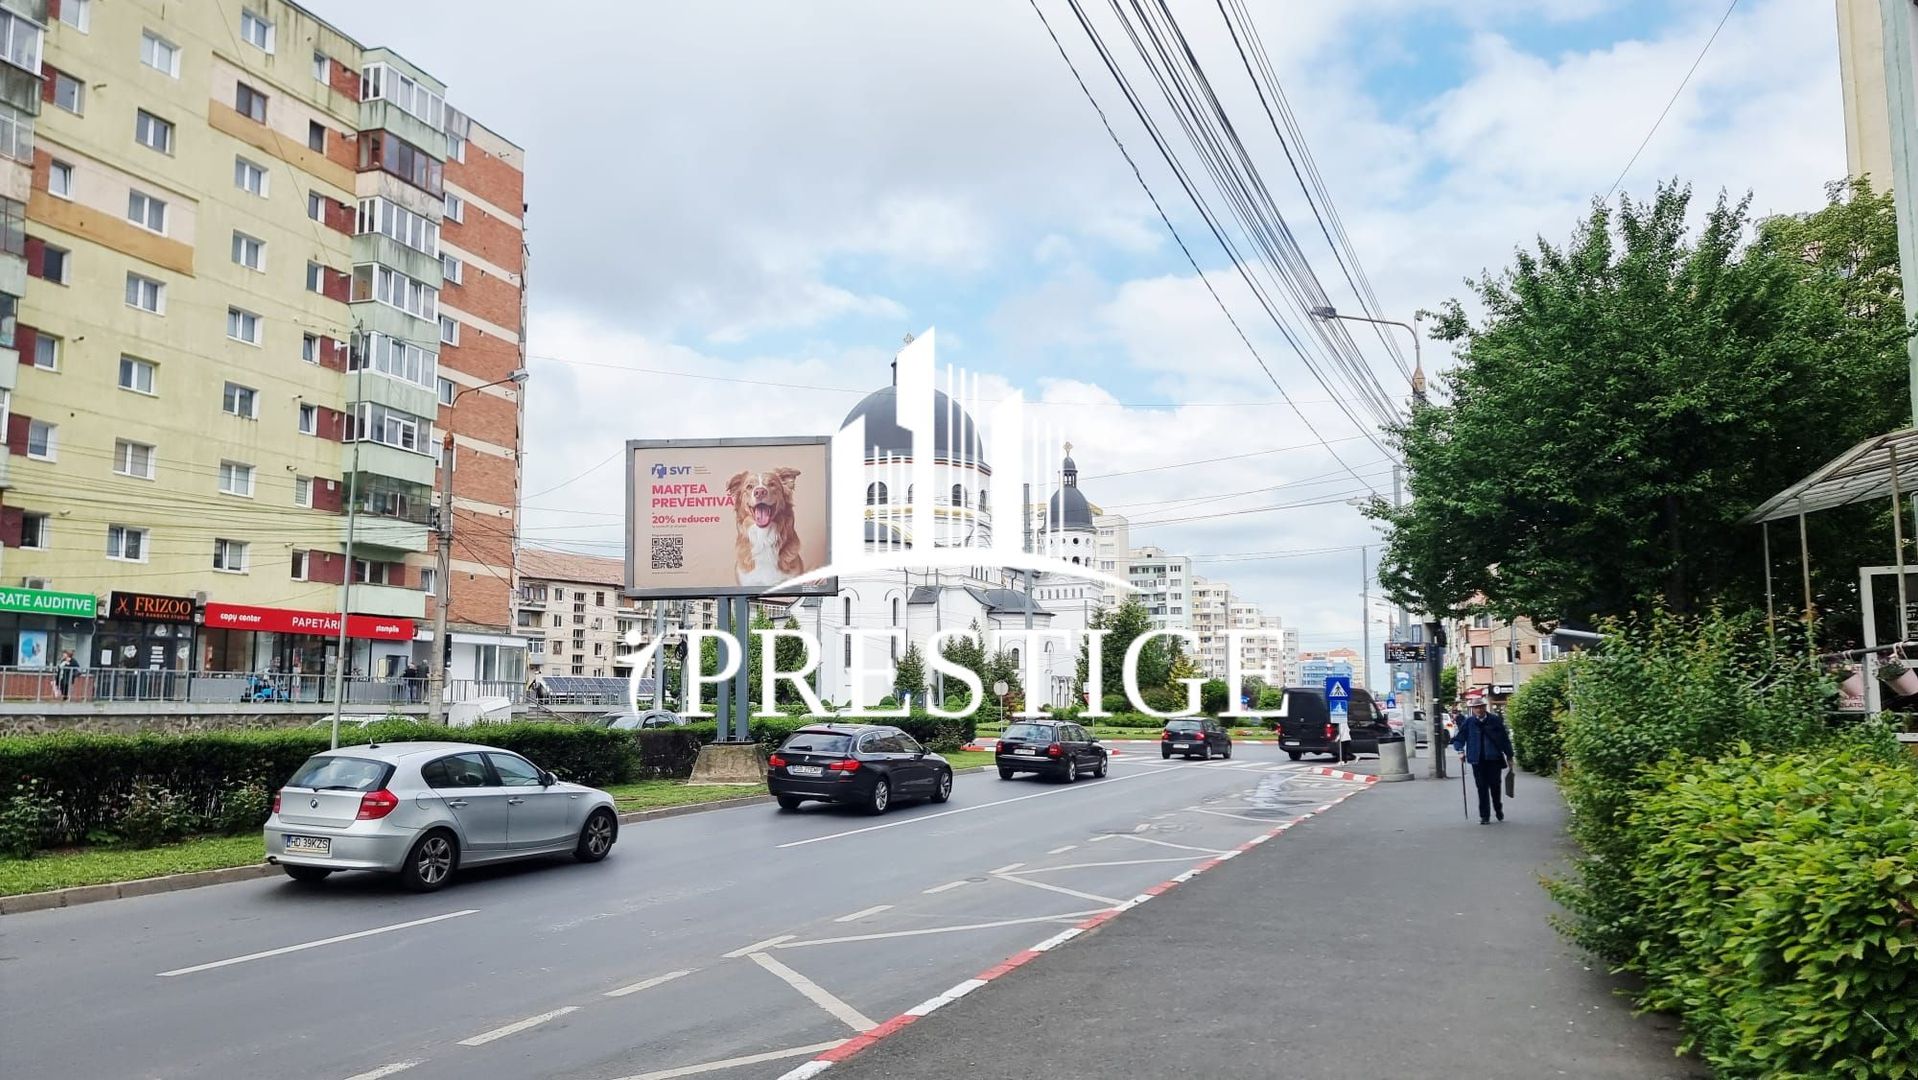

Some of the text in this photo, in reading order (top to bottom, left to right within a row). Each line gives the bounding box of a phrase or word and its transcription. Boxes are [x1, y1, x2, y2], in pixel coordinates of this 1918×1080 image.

[669, 466, 692, 475] SVT
[652, 495, 735, 508] PREVENTIVĂ
[652, 515, 720, 524] 20% reducere
[33, 596, 92, 611] AUDITIVE
[135, 597, 192, 614] FRIZOO
[220, 613, 238, 623] copy
[239, 614, 262, 622] center
[303, 838, 328, 849] 39KZS
